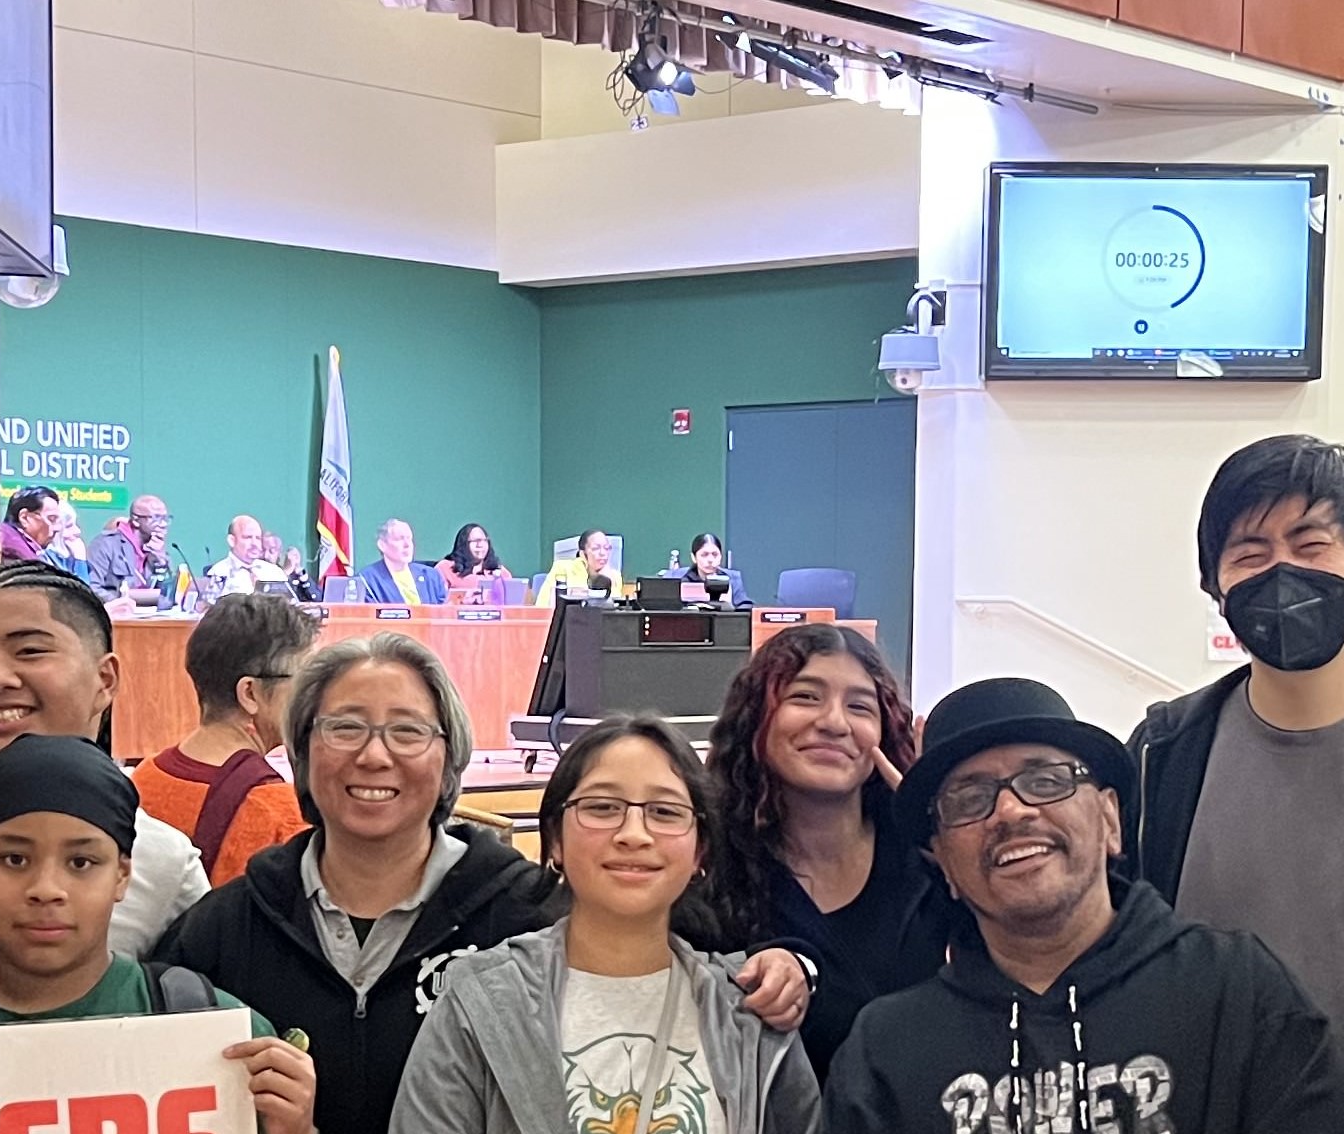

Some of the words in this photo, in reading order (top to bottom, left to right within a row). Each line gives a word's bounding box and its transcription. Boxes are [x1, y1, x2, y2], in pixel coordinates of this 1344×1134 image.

[1115, 252, 1189, 268] 00:00:25
[36, 420, 131, 451] UNIFIED
[22, 450, 130, 482] DISTRICT
